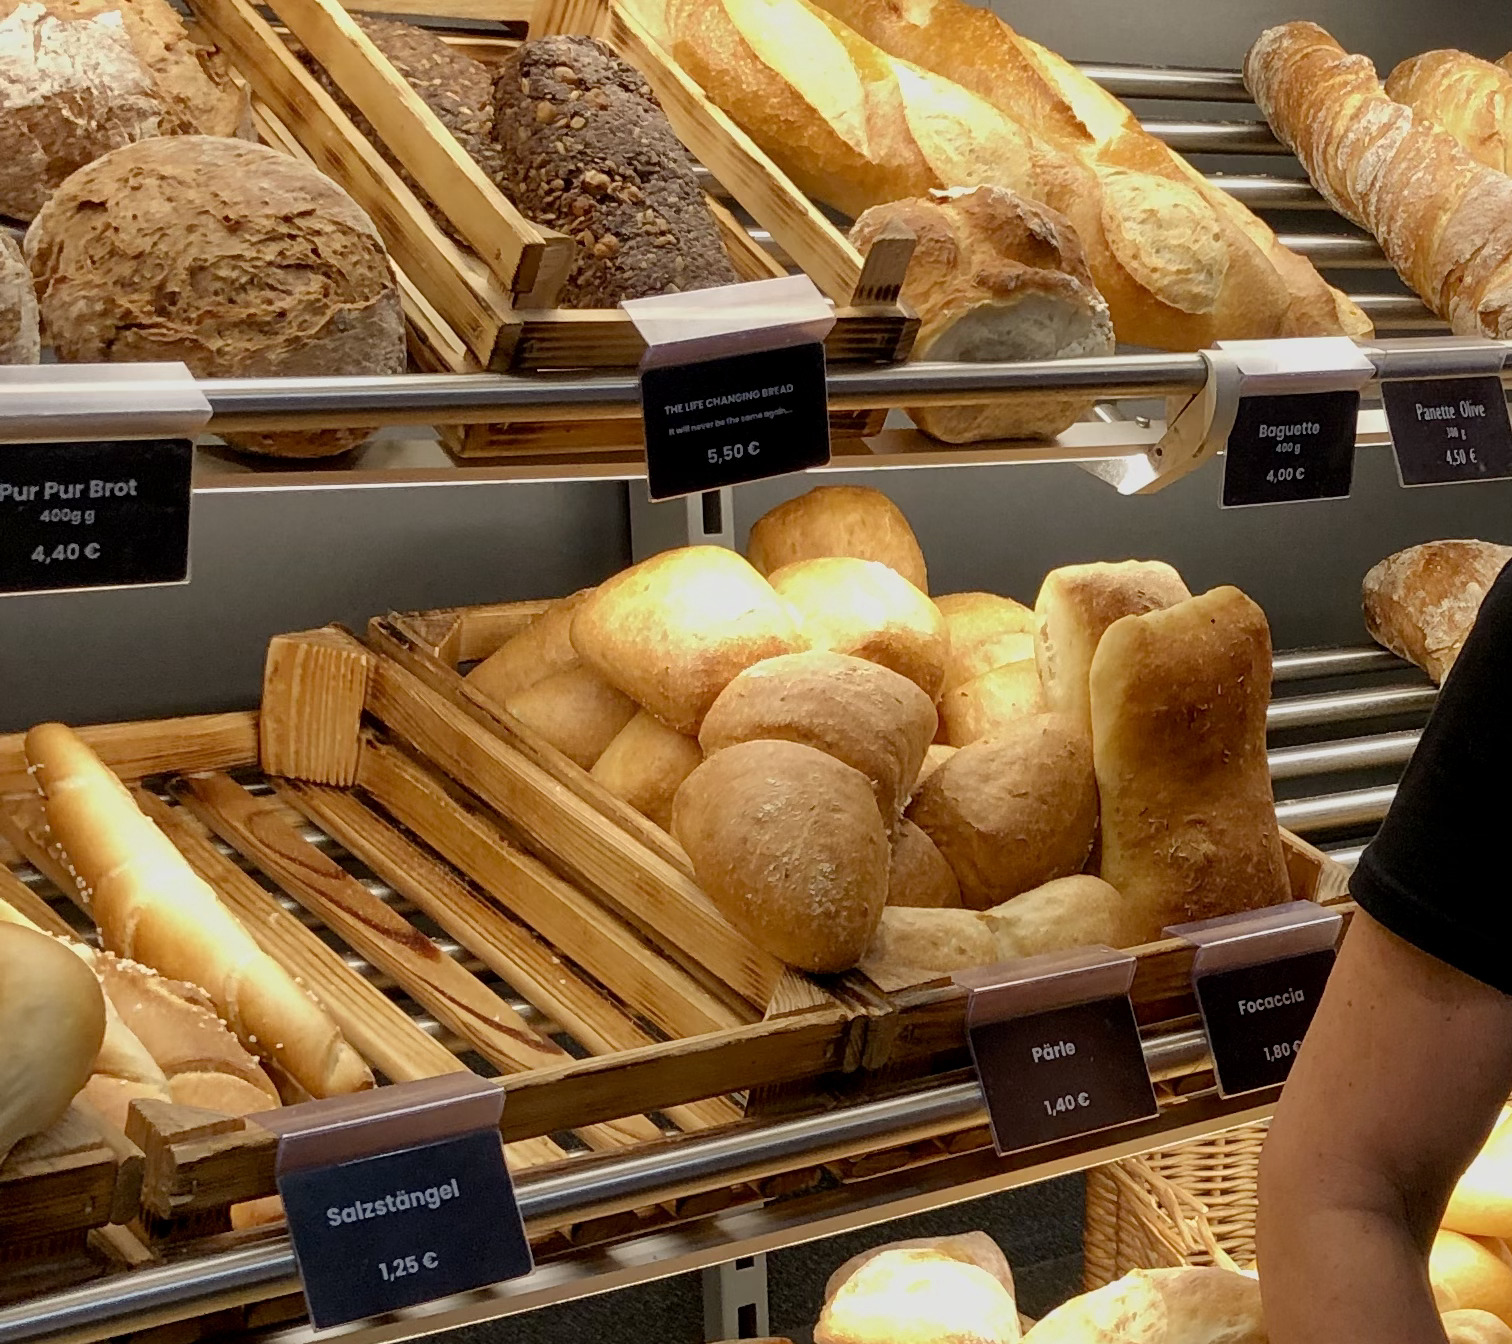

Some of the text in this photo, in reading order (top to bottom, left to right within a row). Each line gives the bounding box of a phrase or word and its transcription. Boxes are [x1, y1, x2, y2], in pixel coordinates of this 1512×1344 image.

[664, 384, 794, 415] THE LIFE CHANGING BREAD
[1416, 400, 1486, 421] Panette Olive
[1259, 421, 1320, 441] Baguette
[707, 441, 760, 464] 5,50 €
[1446, 448, 1477, 467] 4,50 €
[1266, 468, 1305, 484] 4,00 €
[0, 478, 138, 502] Pur Pur Brot
[40, 508, 96, 525] 400g g
[31, 542, 101, 564] 4,40 €
[1238, 987, 1305, 1015] Focaccia
[1031, 1040, 1076, 1063] Pärle
[1263, 1042, 1290, 1062] 1,80
[1043, 1091, 1090, 1116] 1,40 €
[326, 1178, 460, 1227] Salzstängel
[378, 1251, 439, 1282] 1,25 €
